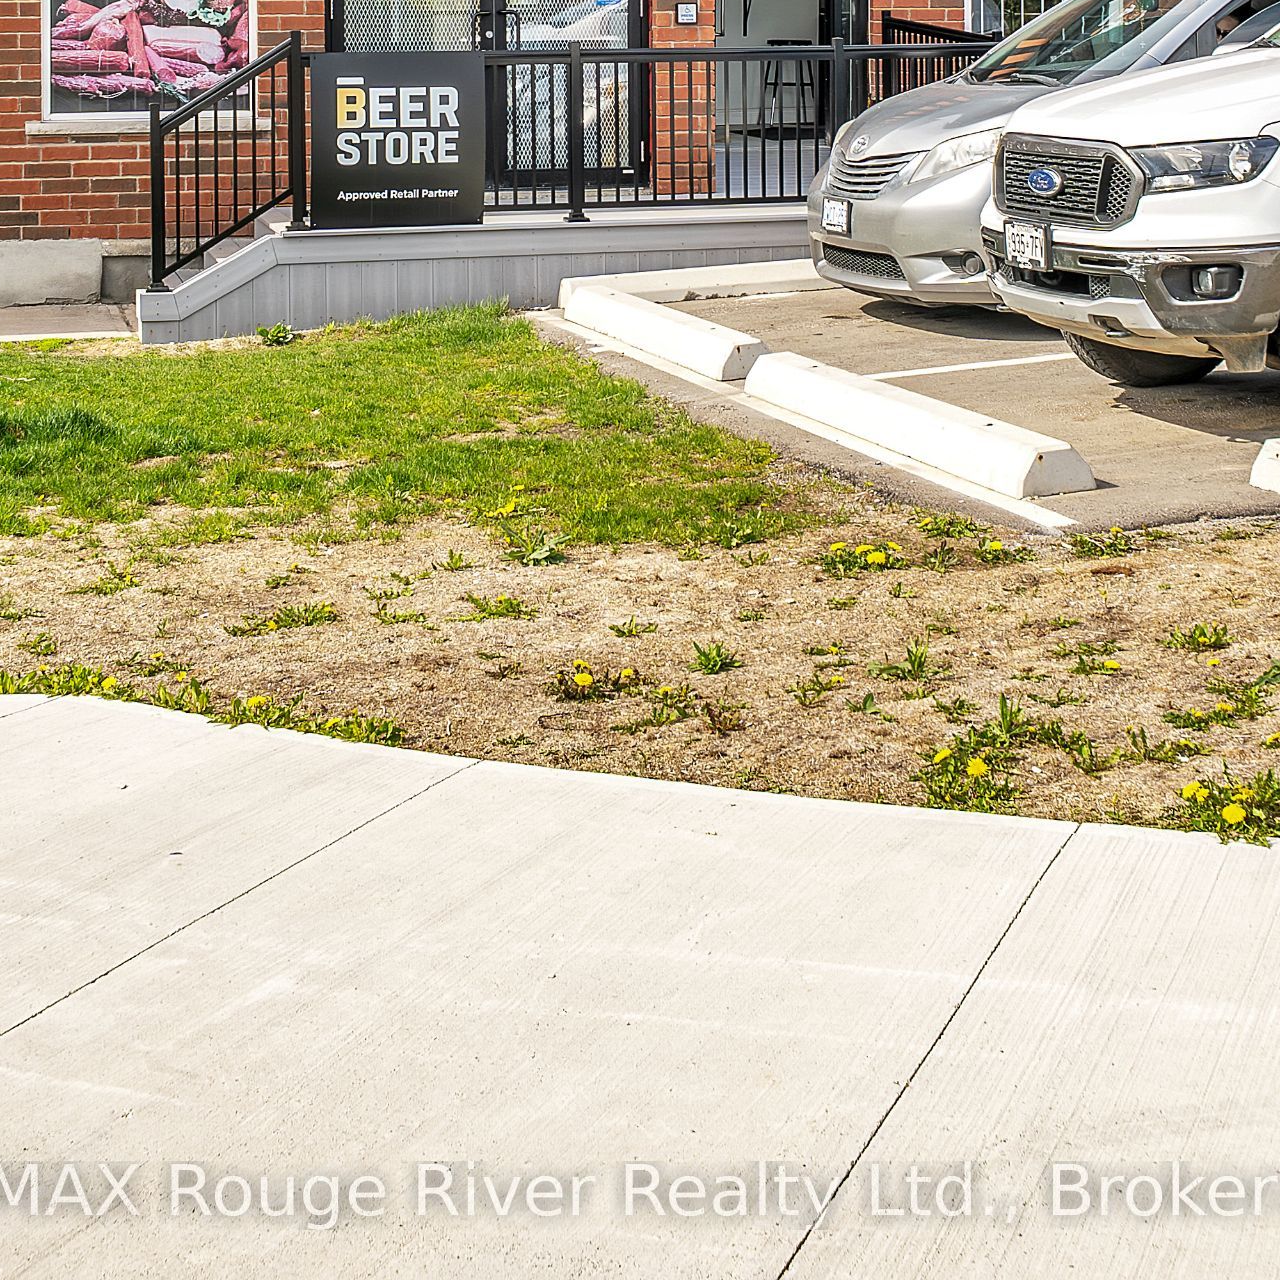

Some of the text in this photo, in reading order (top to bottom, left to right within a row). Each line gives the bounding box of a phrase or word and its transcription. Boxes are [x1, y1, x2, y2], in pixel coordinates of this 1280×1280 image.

[336, 84, 460, 129] BEER
[336, 131, 459, 166] STORE
[337, 189, 459, 202] Approved Retail Partner
